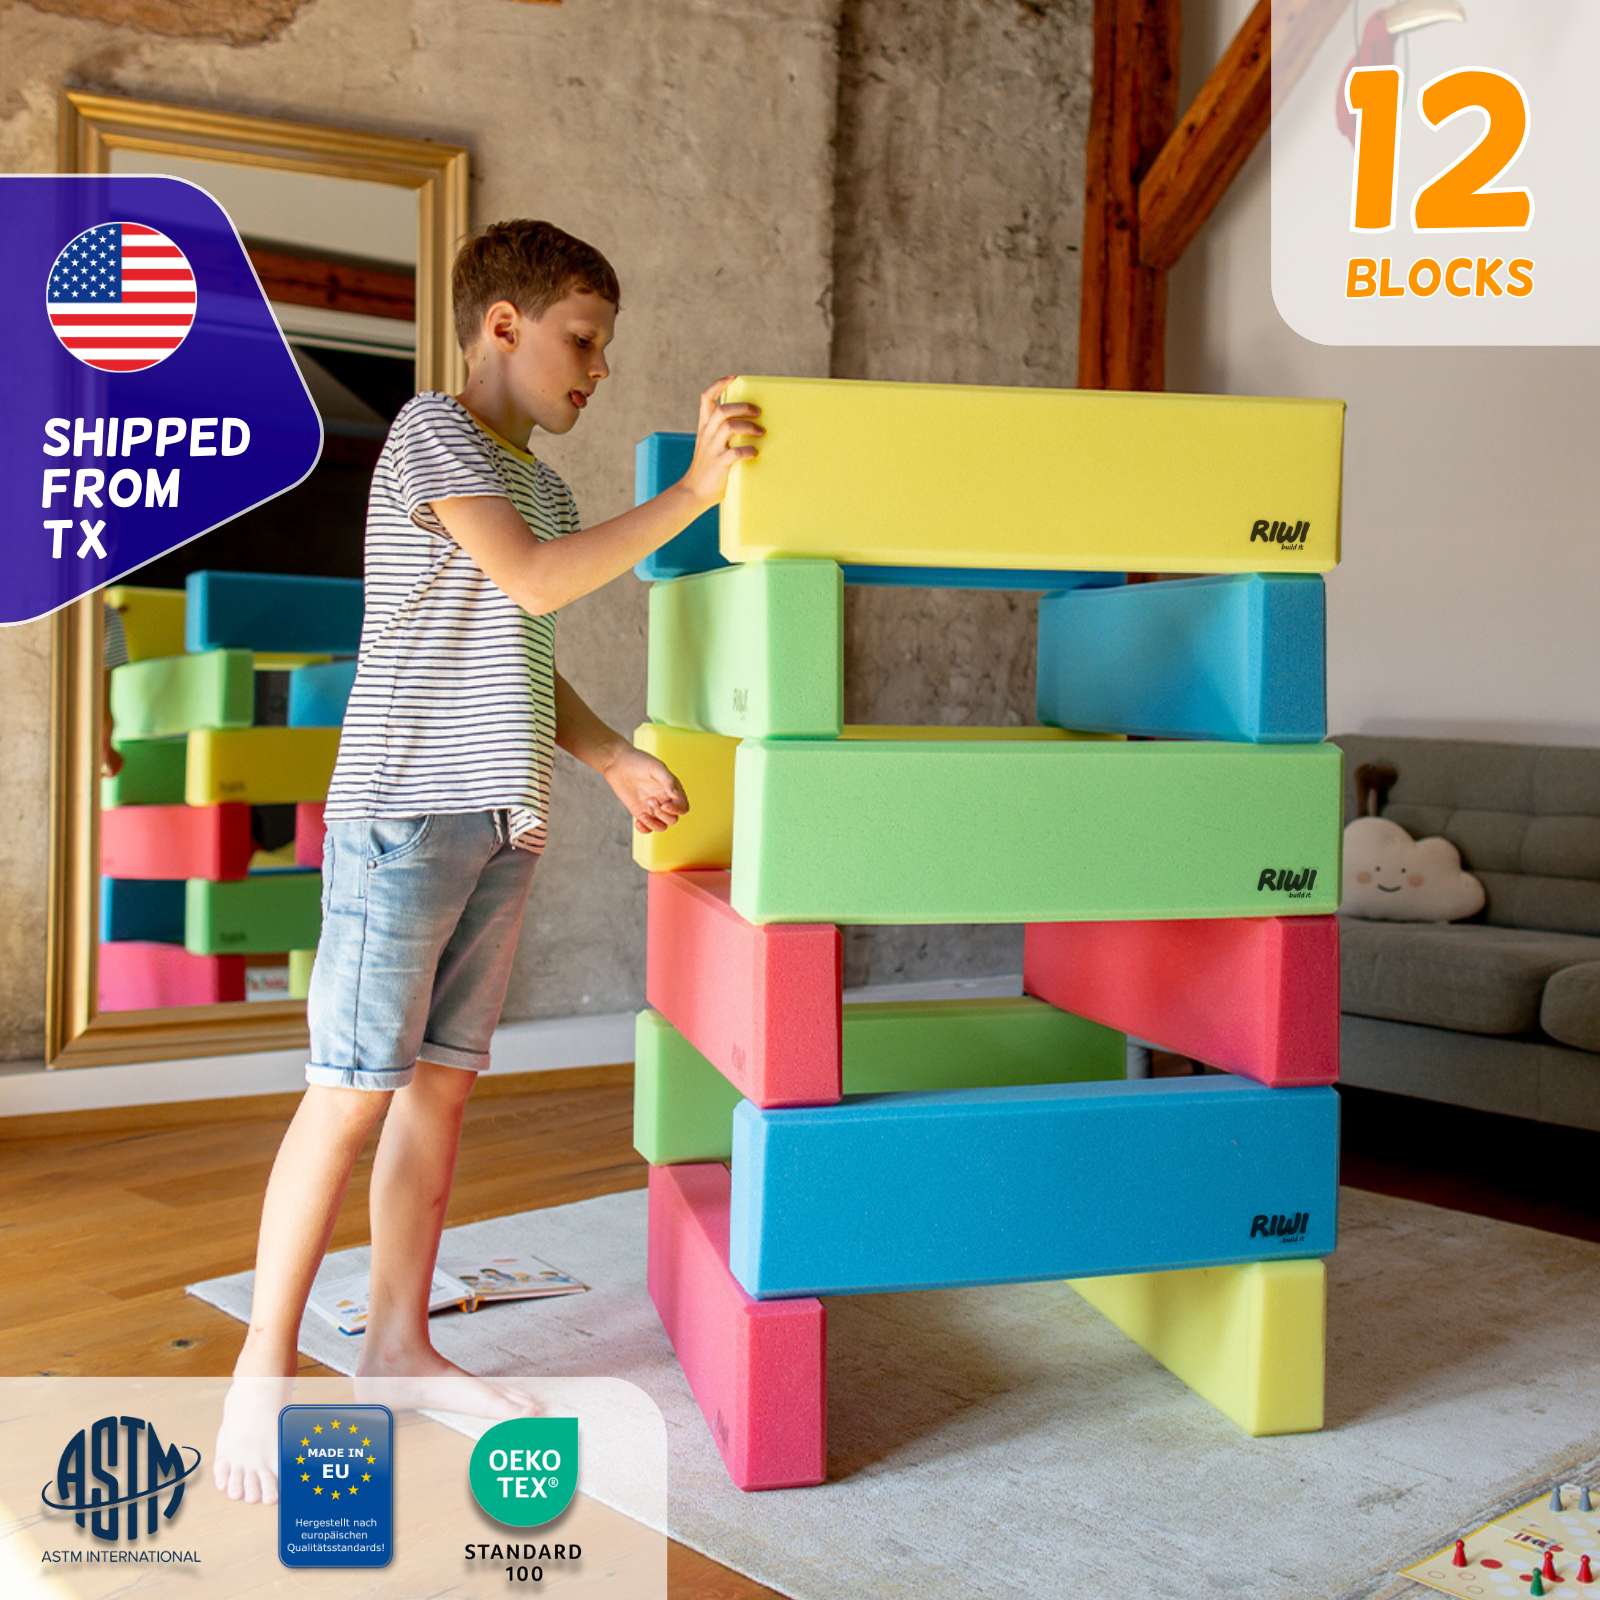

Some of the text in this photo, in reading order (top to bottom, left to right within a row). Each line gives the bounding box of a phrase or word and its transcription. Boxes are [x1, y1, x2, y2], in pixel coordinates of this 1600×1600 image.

[1250, 519, 1311, 543] RIWI
[1257, 868, 1318, 892] RIWI
[1250, 1212, 1310, 1238] RIWI
